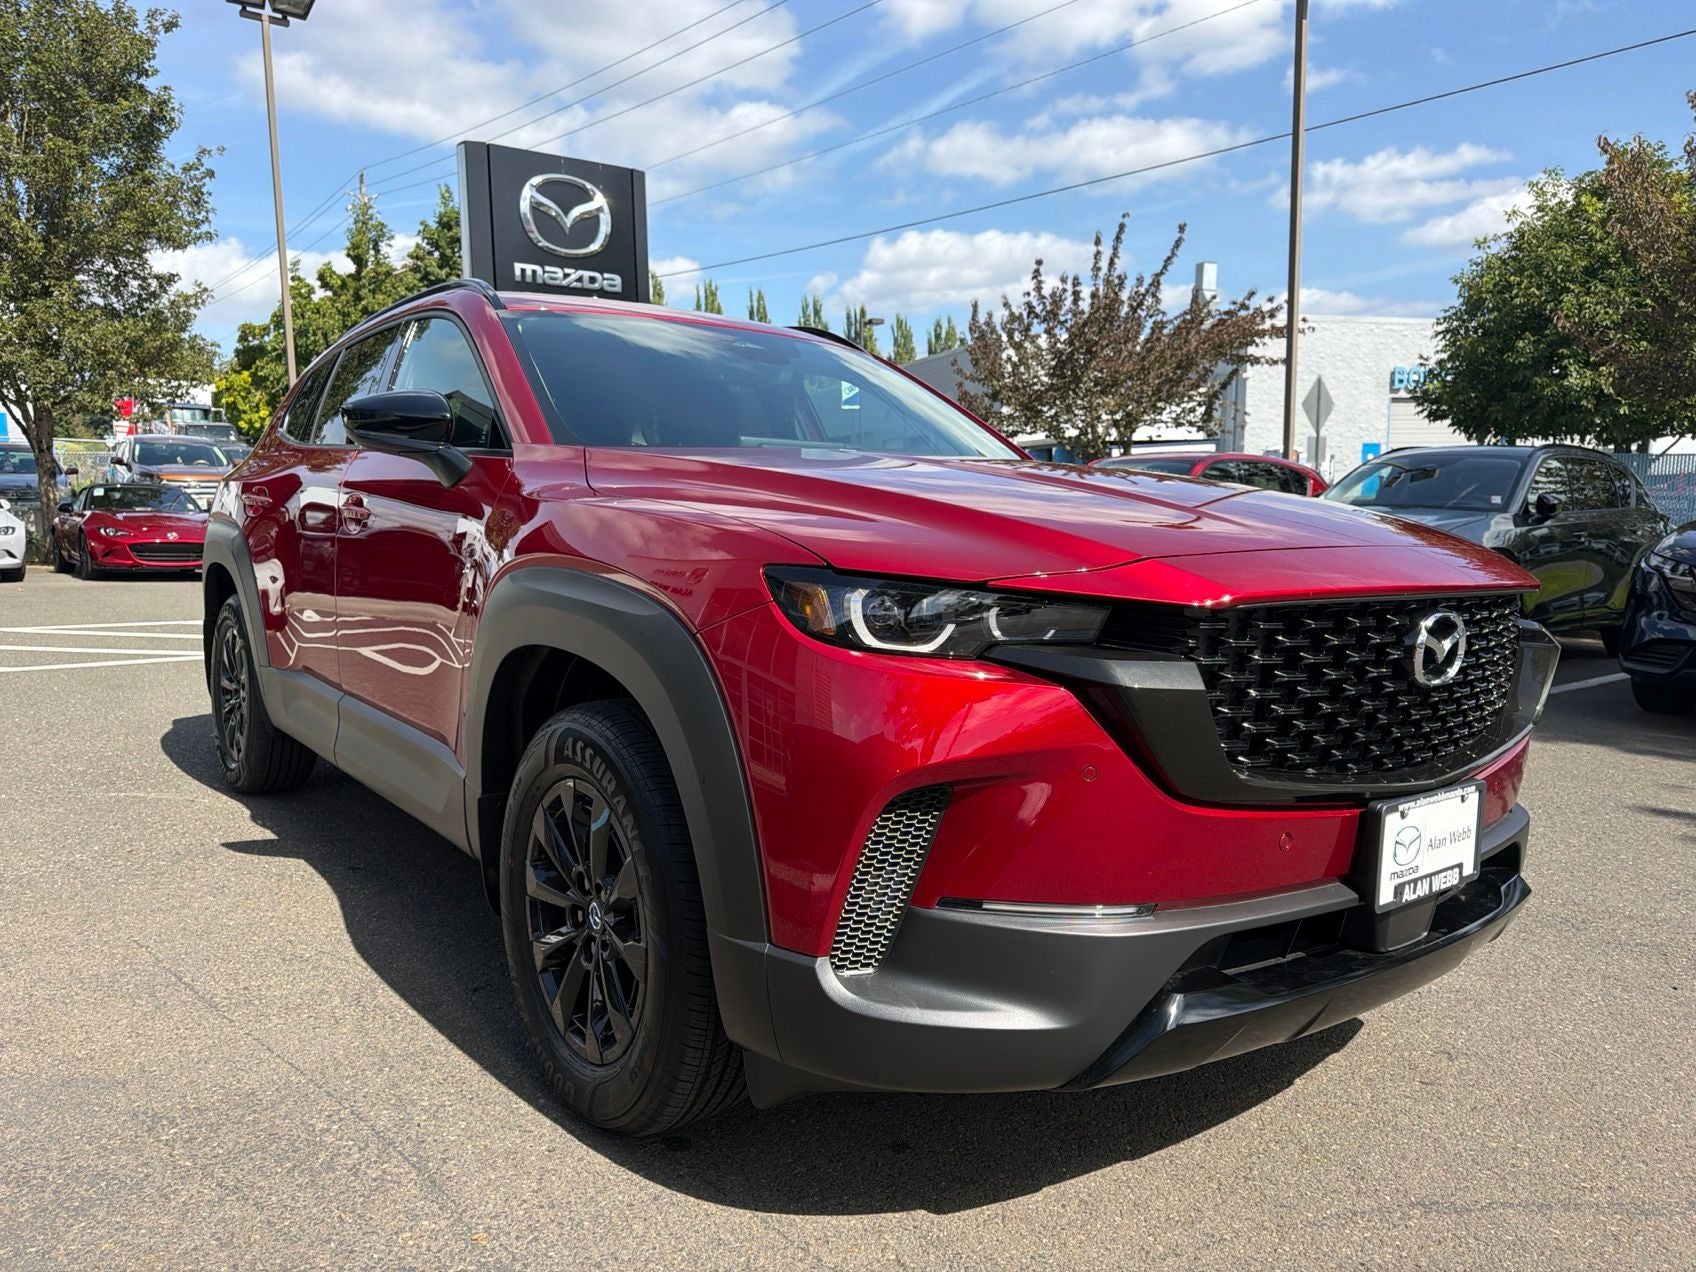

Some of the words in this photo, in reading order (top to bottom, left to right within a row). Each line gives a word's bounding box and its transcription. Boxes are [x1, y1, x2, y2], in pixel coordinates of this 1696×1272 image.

[562, 737, 653, 883] ASSURANCE
[1426, 835, 1447, 852] Alan
[1449, 825, 1472, 845] Webb
[1402, 877, 1431, 903] ALAN
[1431, 867, 1460, 893] WEBB
